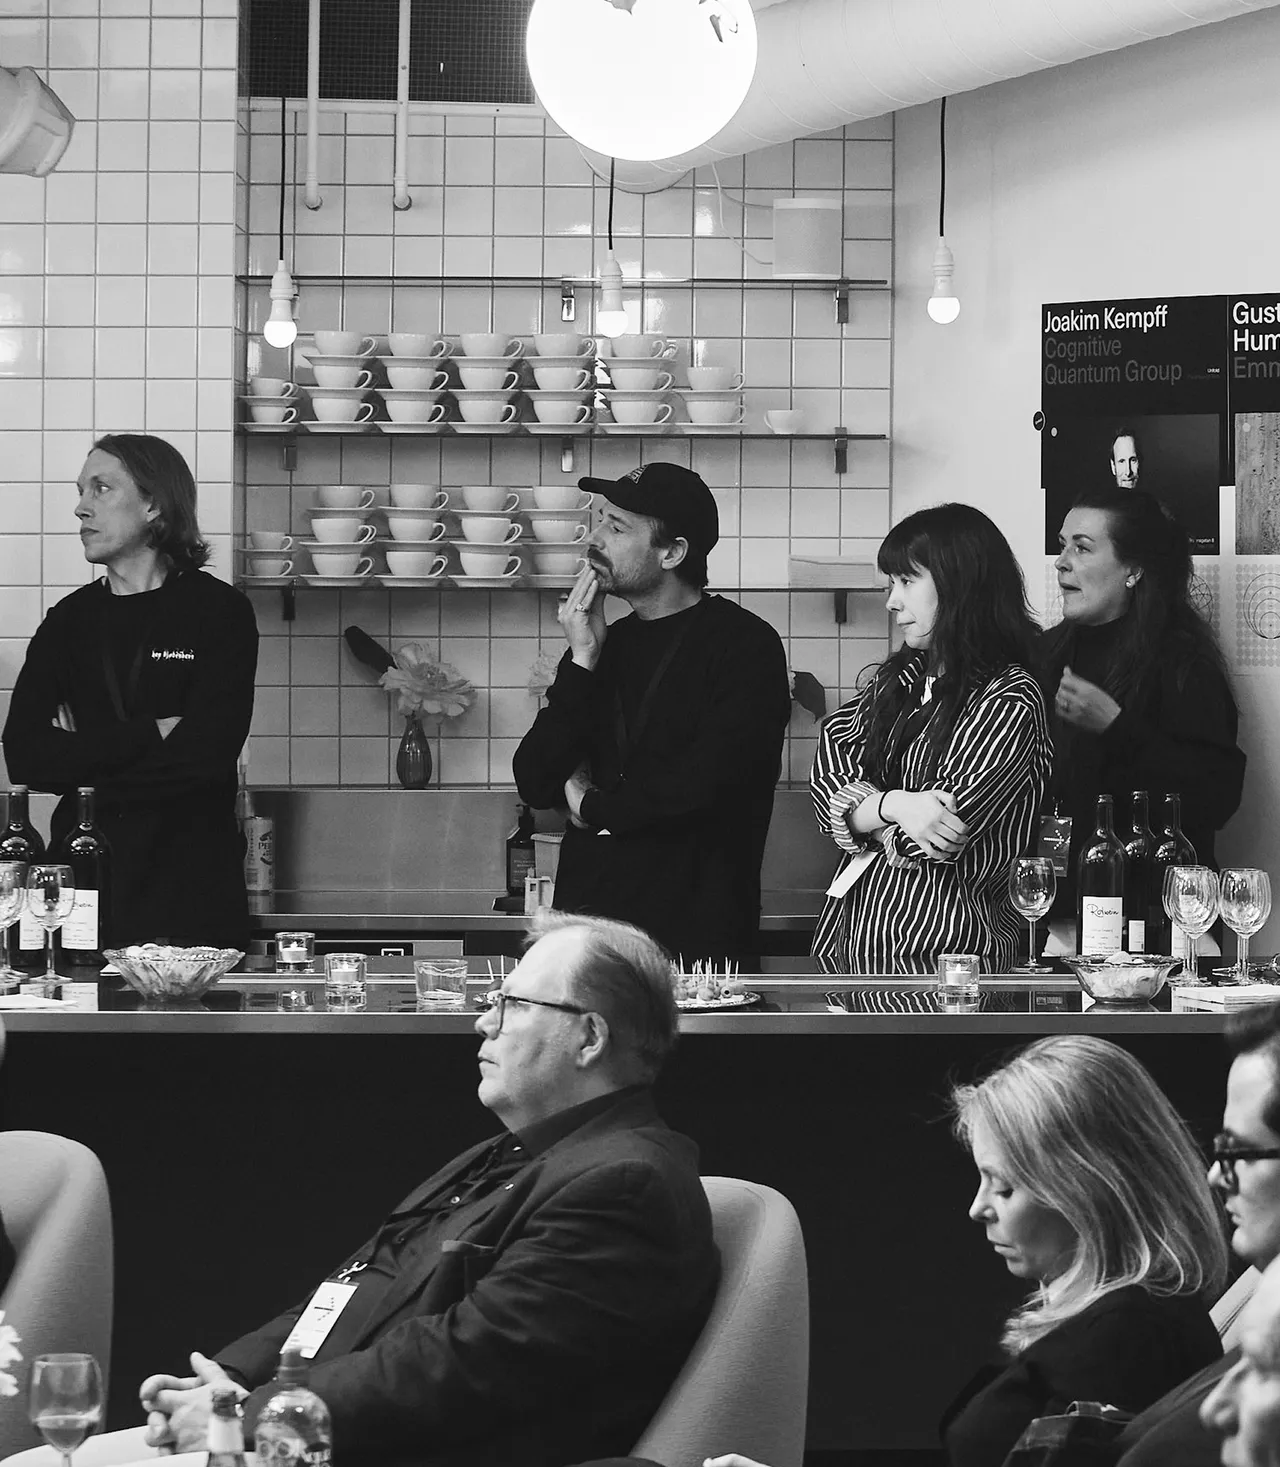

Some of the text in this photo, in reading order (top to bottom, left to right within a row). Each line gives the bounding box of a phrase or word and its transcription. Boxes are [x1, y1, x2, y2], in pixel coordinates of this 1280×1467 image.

[1044, 304, 1169, 333] Joakim Kempff
[1045, 334, 1122, 362] Cognitive
[1045, 359, 1183, 386] Quantum Group
